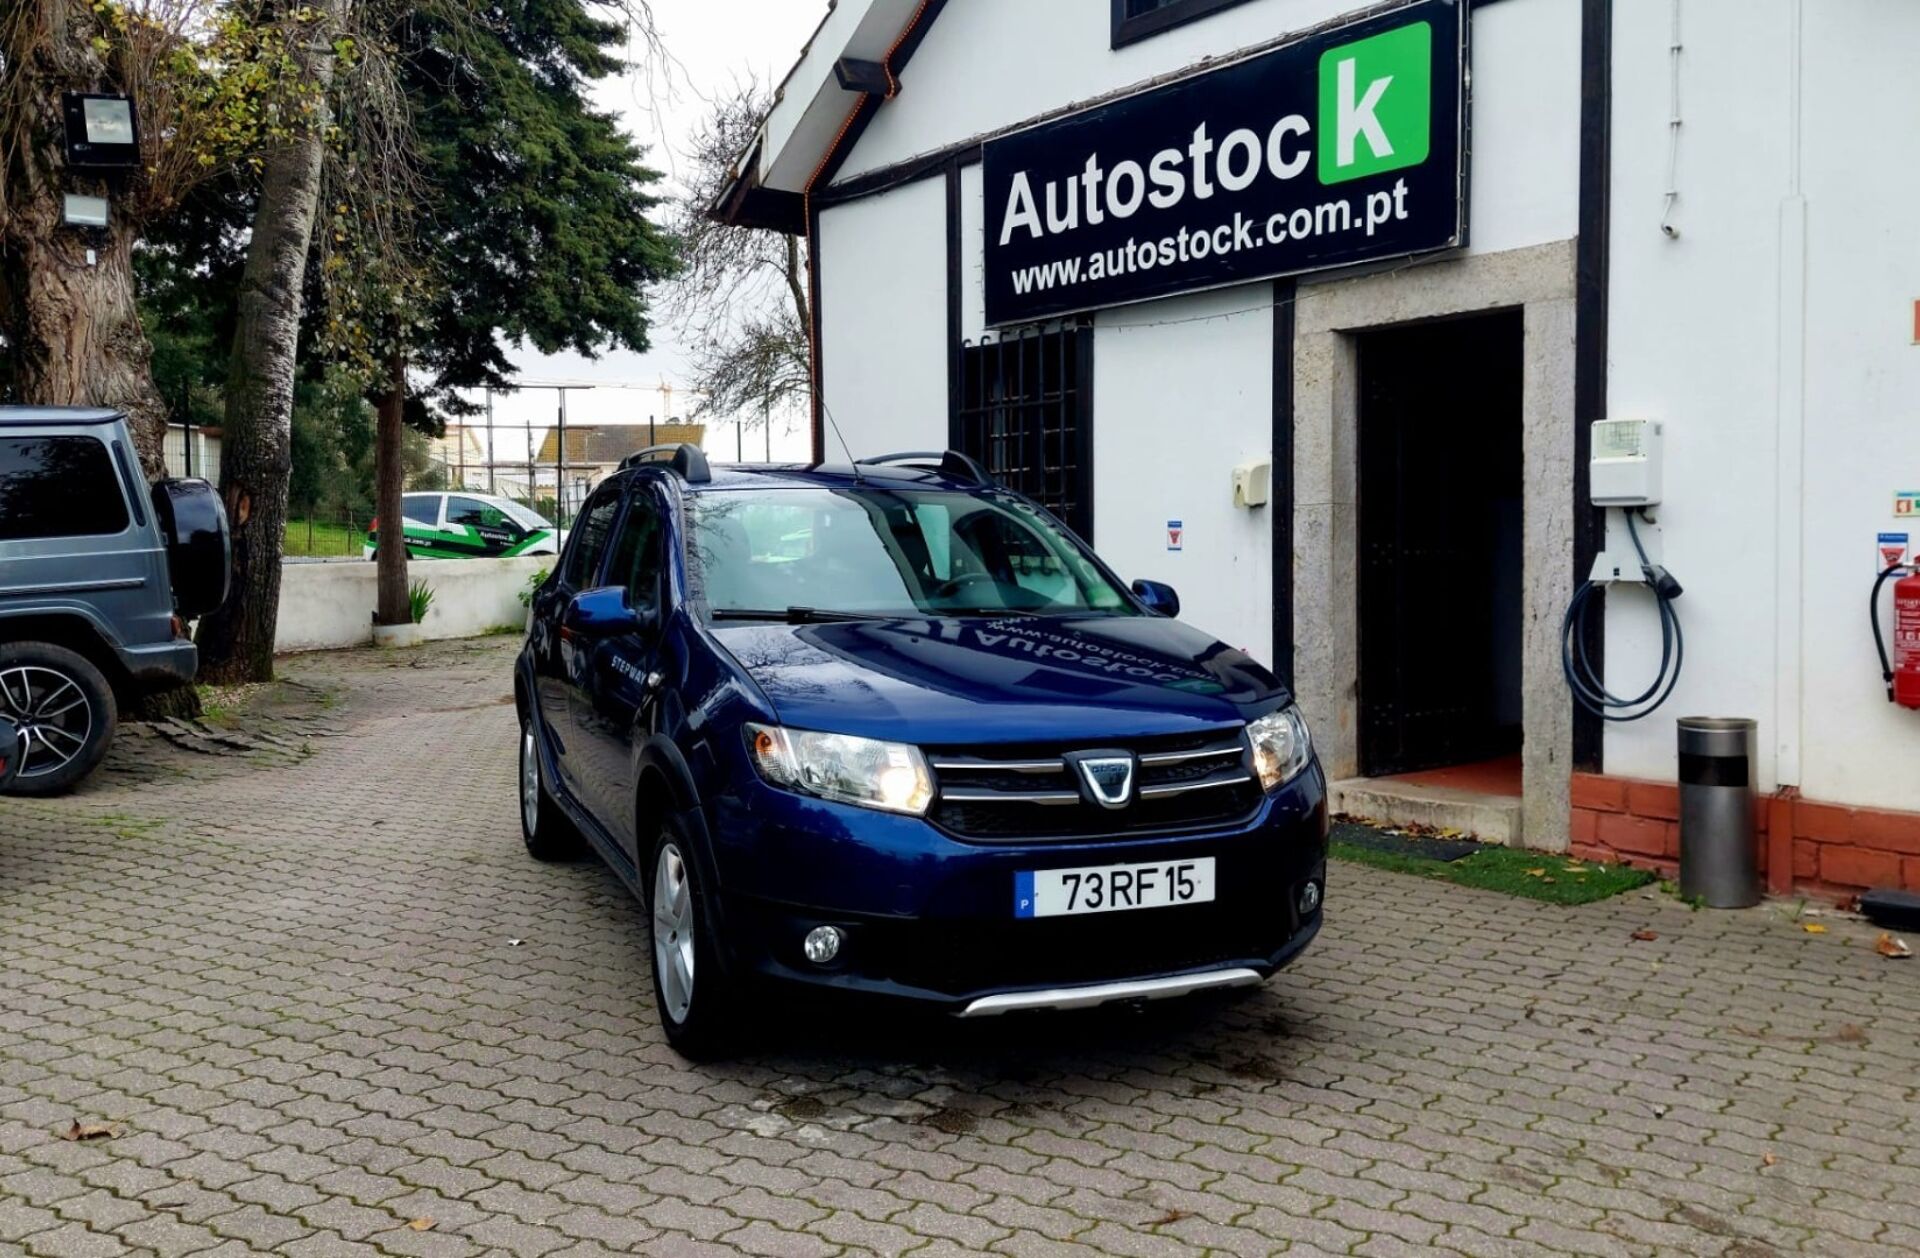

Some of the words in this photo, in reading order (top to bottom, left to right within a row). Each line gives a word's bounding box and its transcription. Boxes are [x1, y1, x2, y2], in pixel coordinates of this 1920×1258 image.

[1000, 57, 1395, 246] Autostock
[1011, 178, 1409, 295] www.autostock.com.pt
[611, 655, 647, 686] STEPWAY
[1020, 899, 1030, 910] P
[1062, 864, 1196, 911] 73RF15
